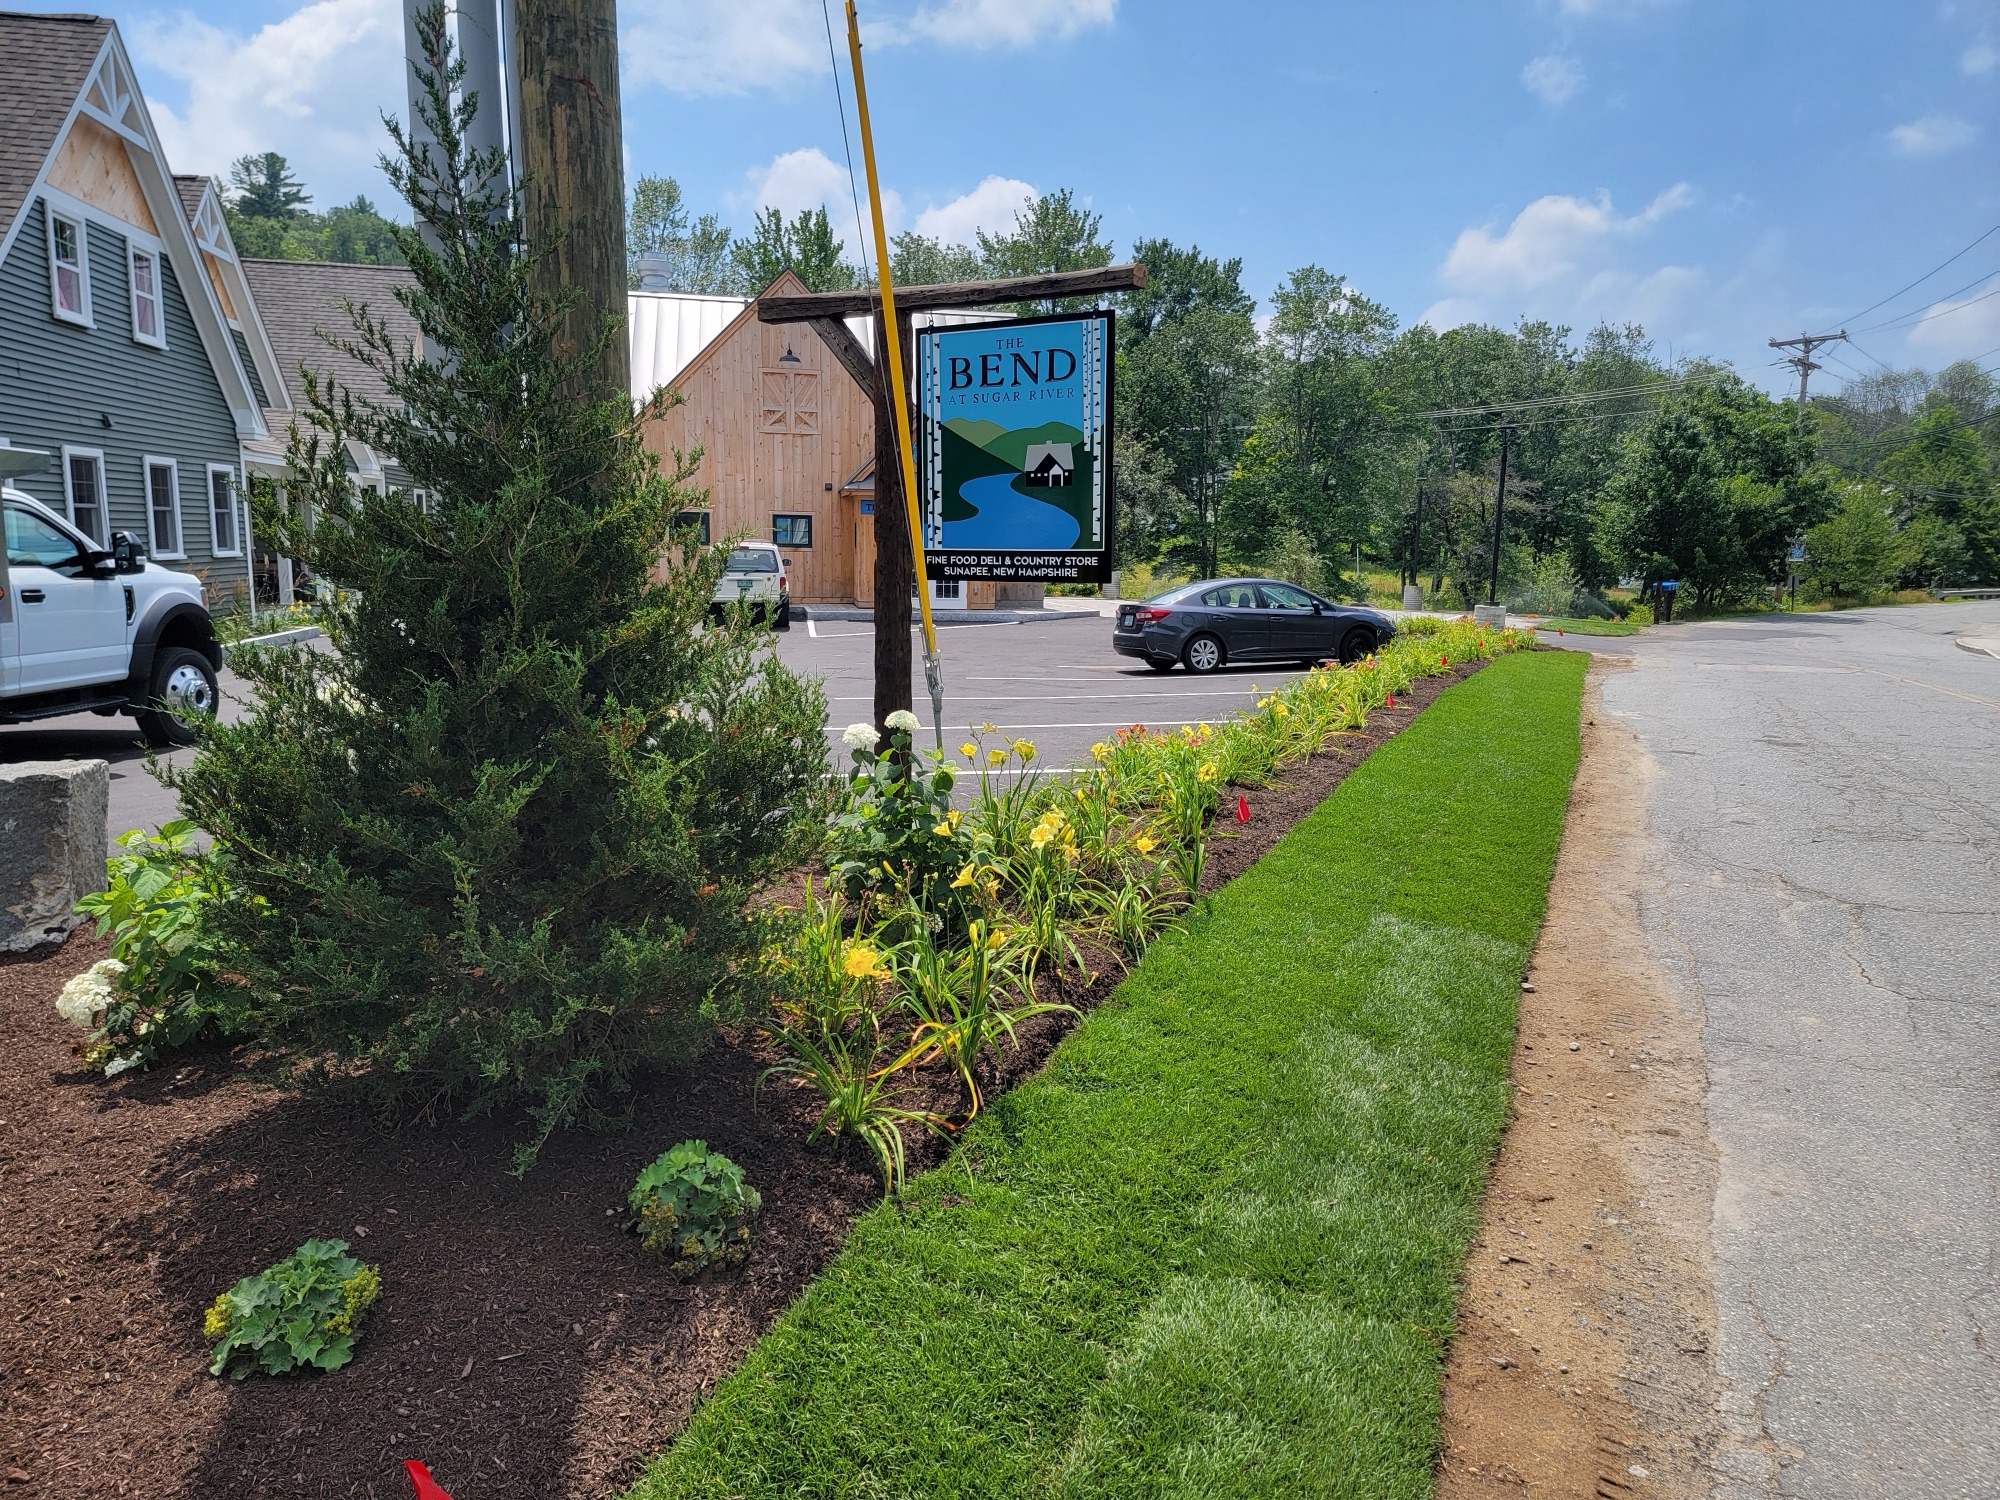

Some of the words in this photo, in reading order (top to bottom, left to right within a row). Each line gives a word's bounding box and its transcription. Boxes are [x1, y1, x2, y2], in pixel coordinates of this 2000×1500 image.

[996, 337, 1025, 350] THE
[948, 348, 1076, 390] BEND
[949, 394, 967, 405] AT
[973, 391, 1021, 404] SUGAR
[1029, 388, 1075, 401] RIVER
[926, 555, 948, 565] FINE
[950, 555, 978, 565] FOOD
[980, 556, 1002, 565] DELI
[1004, 556, 1012, 565] &
[1013, 556, 1062, 566] COUNTRY
[1065, 556, 1098, 566] STORE
[944, 566, 991, 576] SUNAPEE,
[993, 567, 1016, 576] NEW
[1018, 567, 1078, 577] HAMPSHIRE
